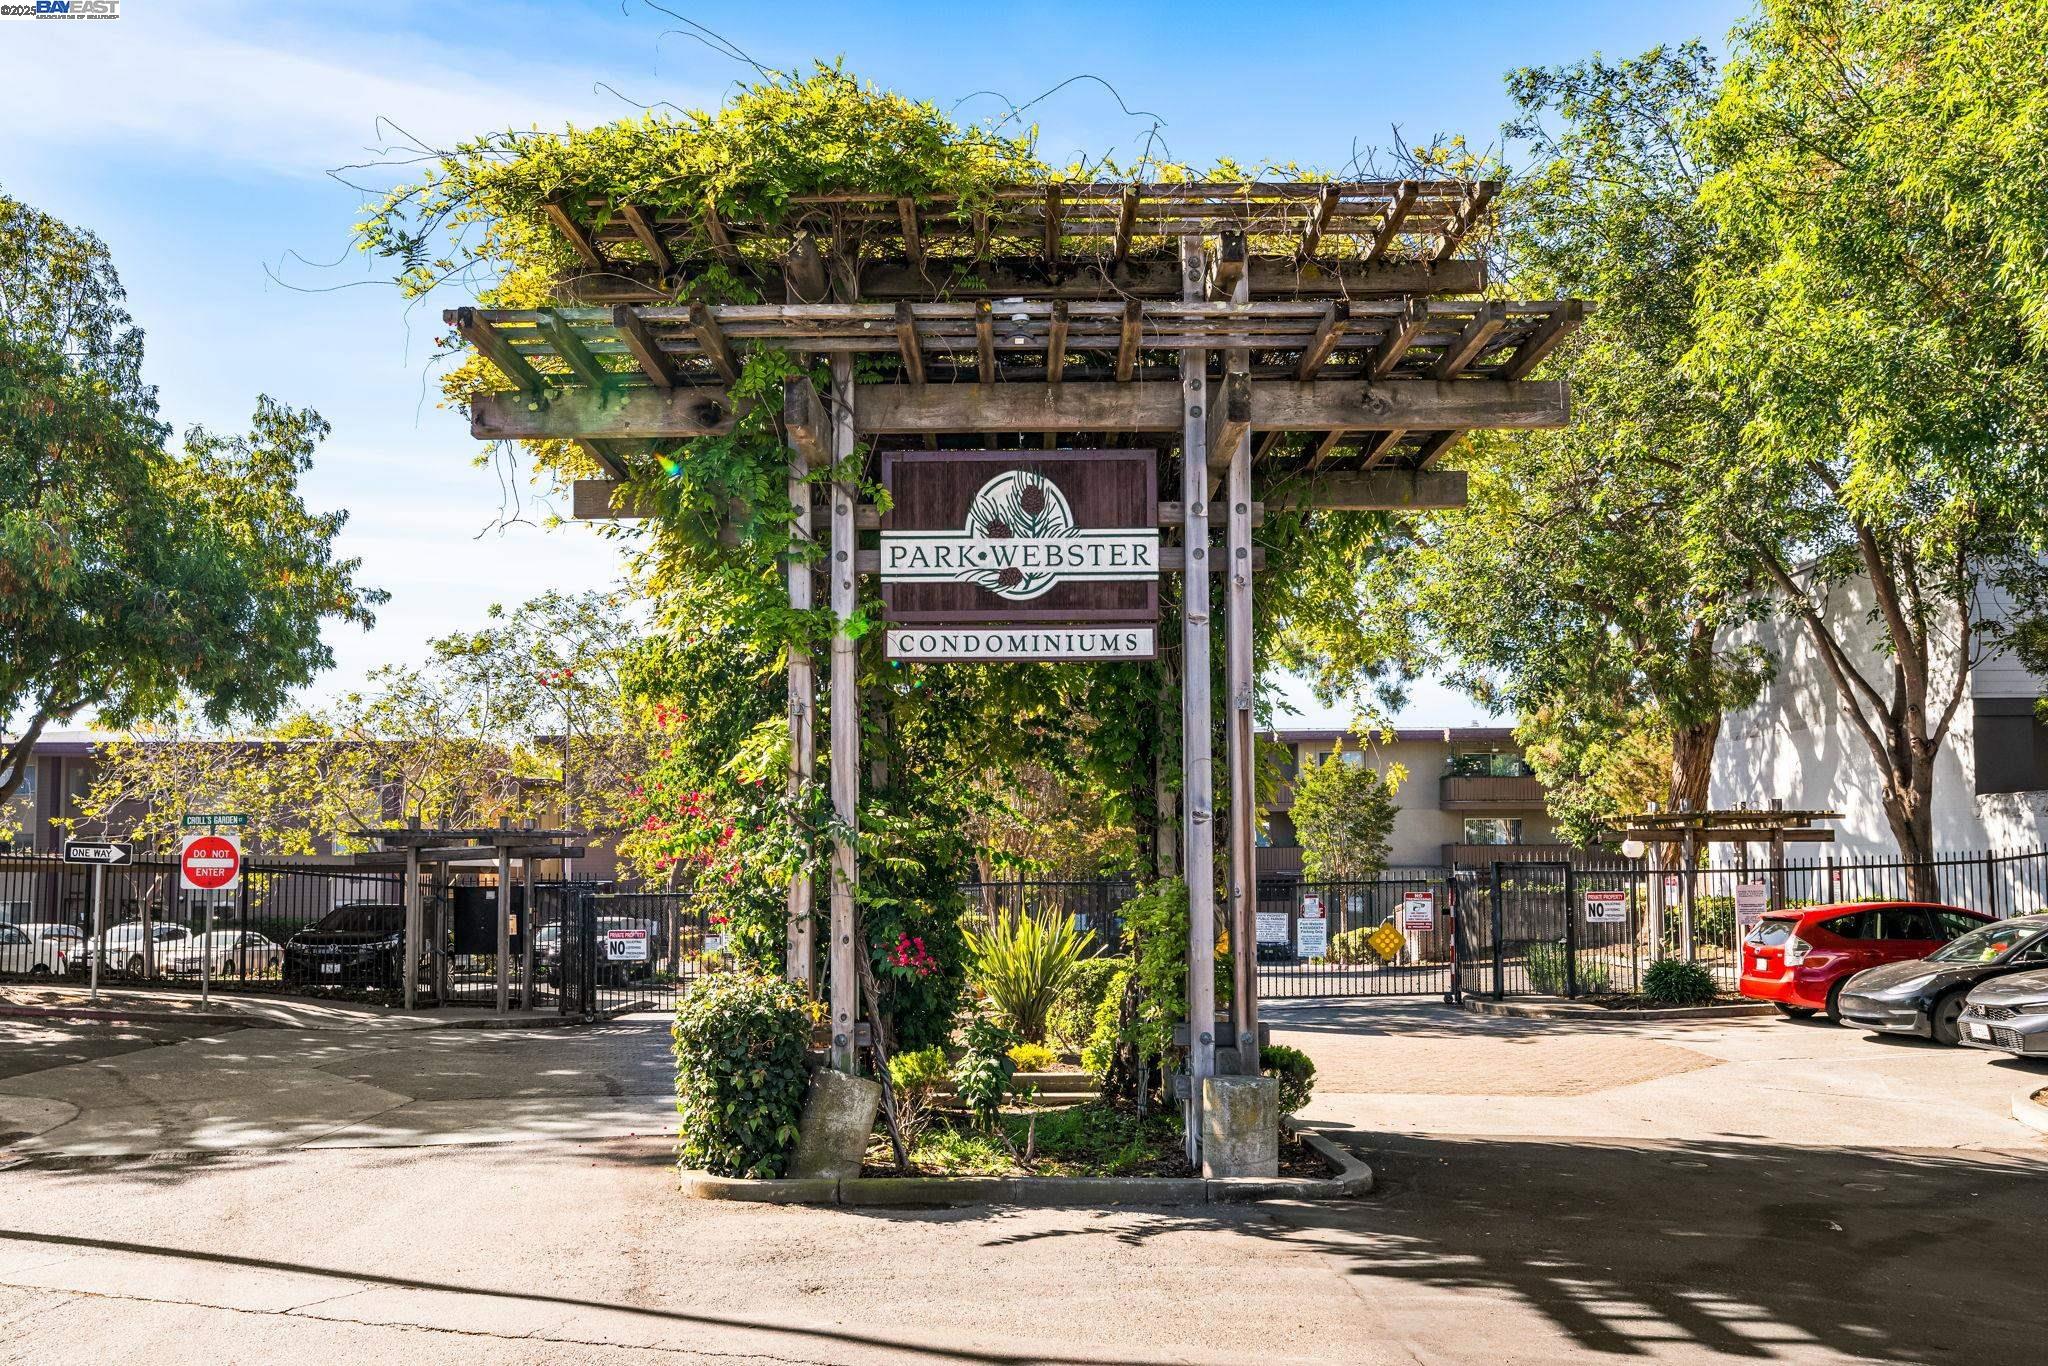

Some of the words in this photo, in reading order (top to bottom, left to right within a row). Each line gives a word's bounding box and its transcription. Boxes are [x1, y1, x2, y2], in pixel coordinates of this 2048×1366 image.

[899, 632, 1138, 654] CONDOMINIUMS
[187, 816, 212, 825] CROLL'S
[213, 815, 238, 825] GARDEN
[72, 848, 90, 857] ONE
[93, 849, 112, 858] WAY
[193, 849, 207, 858] DO
[212, 849, 230, 858] NOT
[195, 868, 225, 877] ENTER
[1588, 903, 1604, 917] NO
[610, 941, 625, 955] NO
